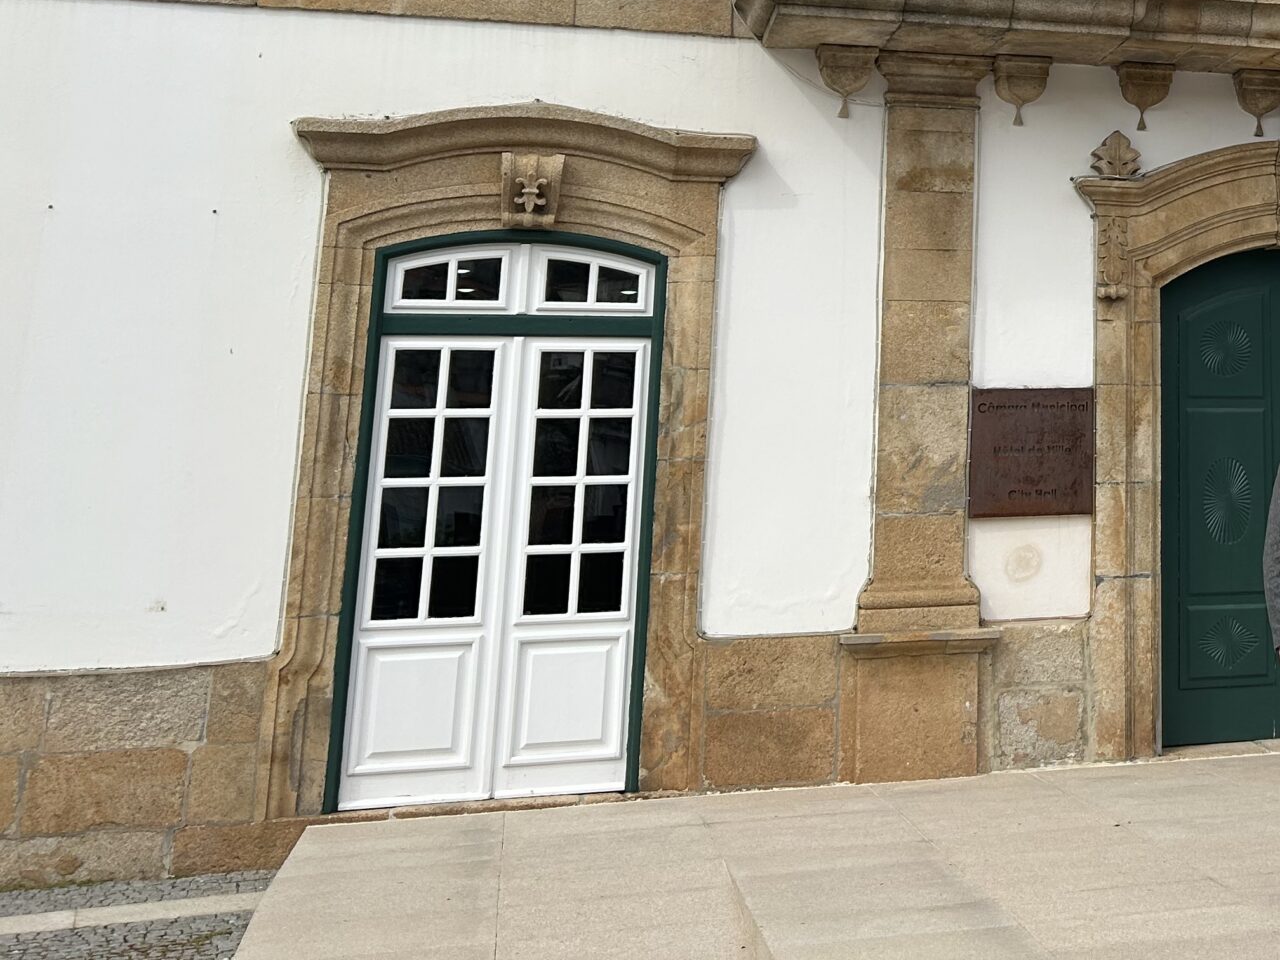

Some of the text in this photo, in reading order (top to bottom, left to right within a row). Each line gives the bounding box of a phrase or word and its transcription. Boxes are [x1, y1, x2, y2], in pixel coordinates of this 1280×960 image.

[977, 401, 1089, 414] Câmara Municipal
[1008, 488, 1057, 501] City Hall
